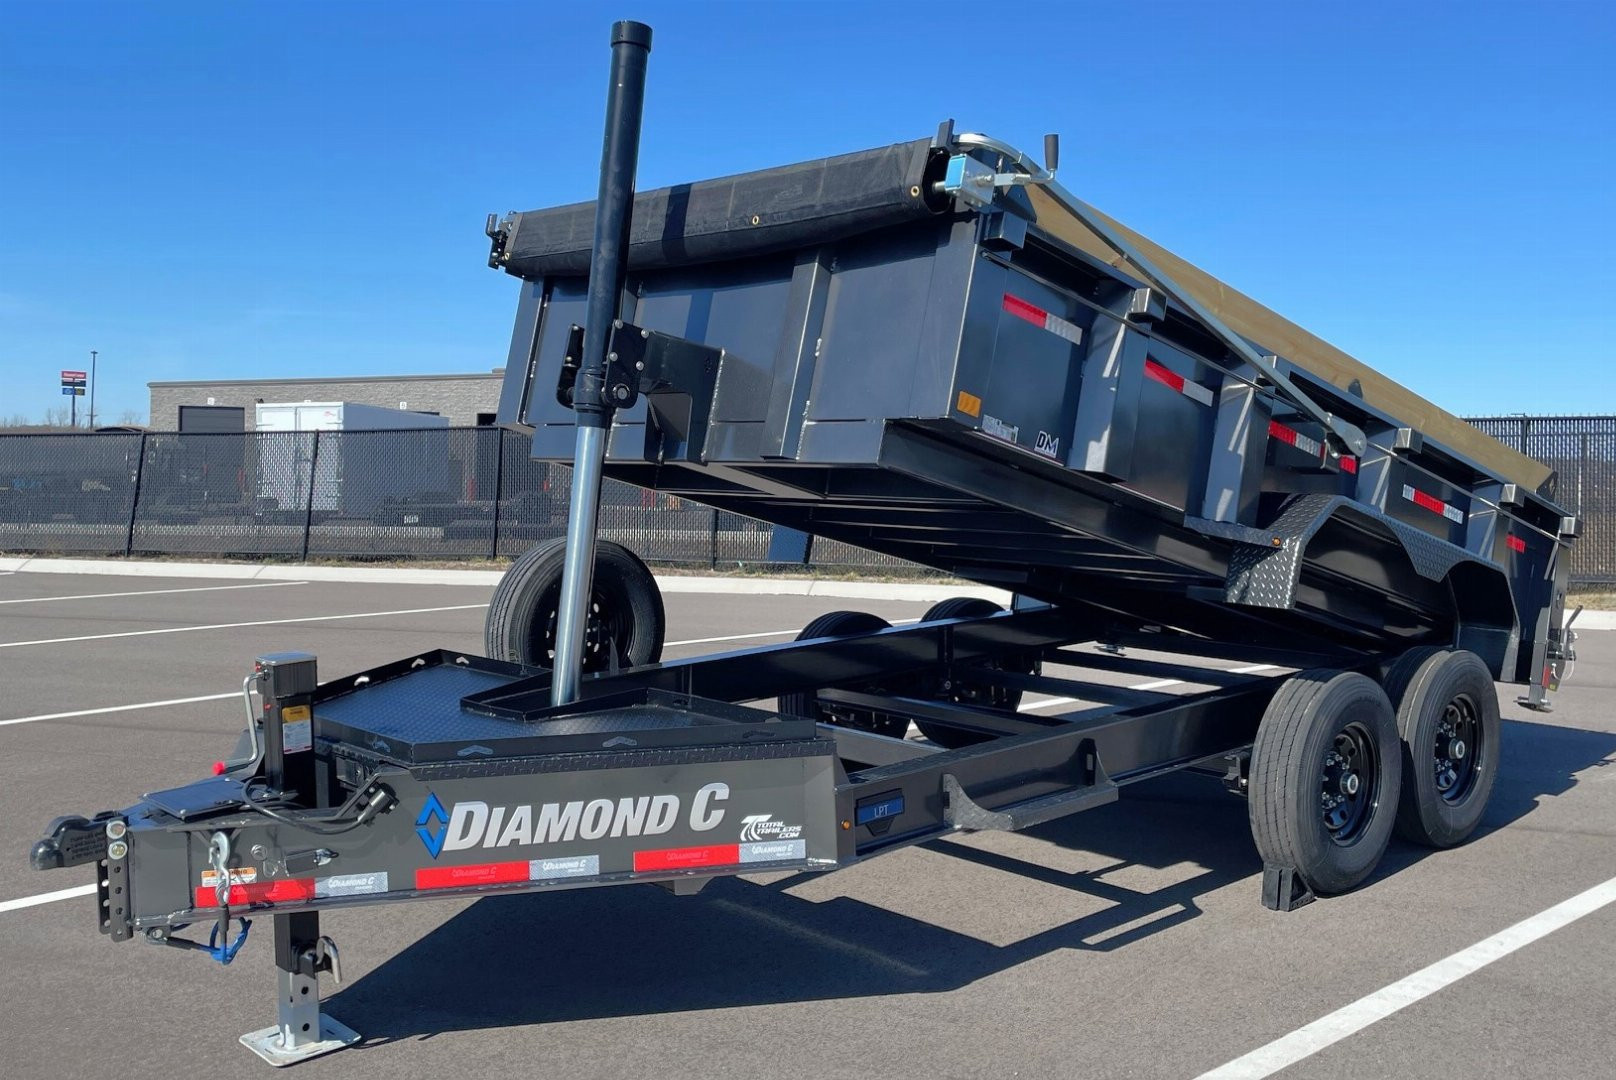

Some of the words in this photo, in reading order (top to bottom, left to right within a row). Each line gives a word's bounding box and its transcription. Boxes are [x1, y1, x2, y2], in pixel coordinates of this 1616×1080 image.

[1034, 430, 1059, 458] DM
[442, 794, 680, 851] DIAMOND
[689, 782, 730, 832] C
[874, 804, 889, 818] LPT
[756, 826, 802, 835] TRAILERS
[757, 820, 785, 829] TOTAL
